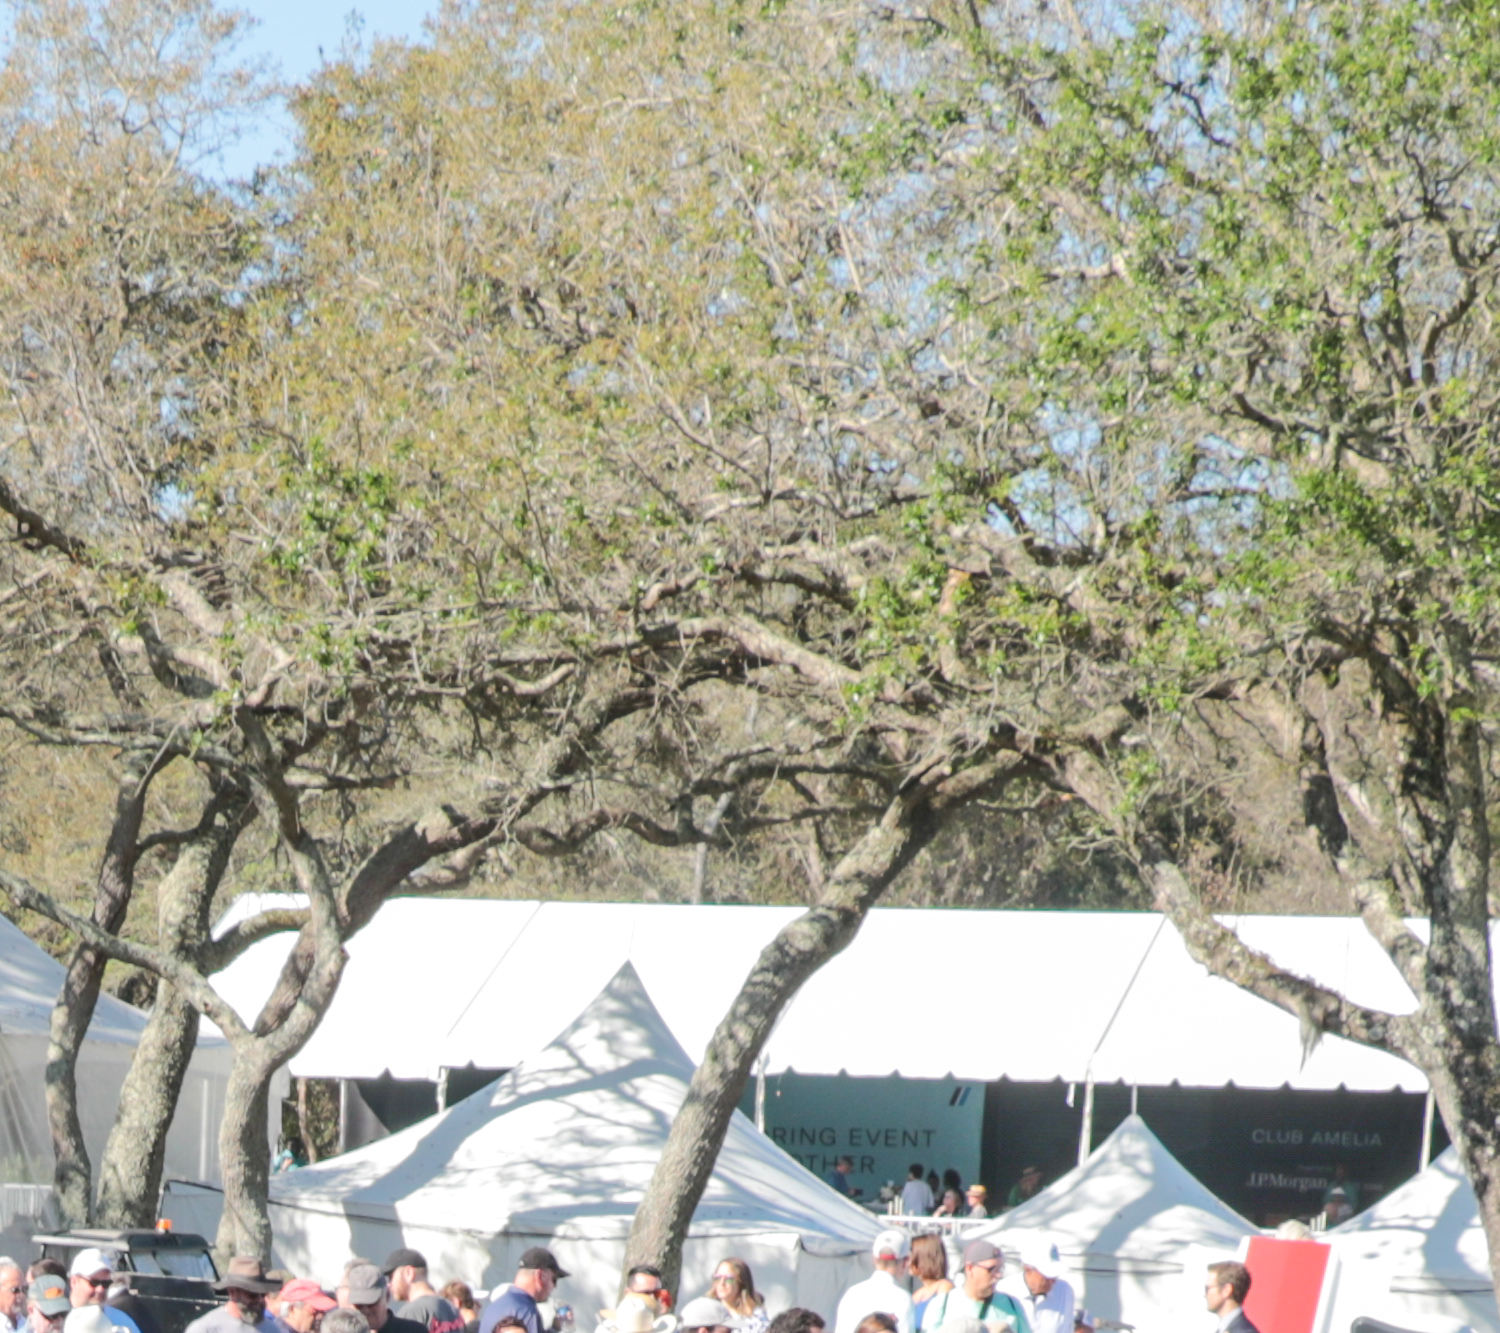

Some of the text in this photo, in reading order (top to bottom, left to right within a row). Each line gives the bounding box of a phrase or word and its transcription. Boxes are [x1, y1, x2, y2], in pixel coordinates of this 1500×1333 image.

[772, 1126, 937, 1148] RING EVENT
[1251, 1128, 1383, 1147] CLUB AMELIA
[793, 1154, 876, 1175] THR
